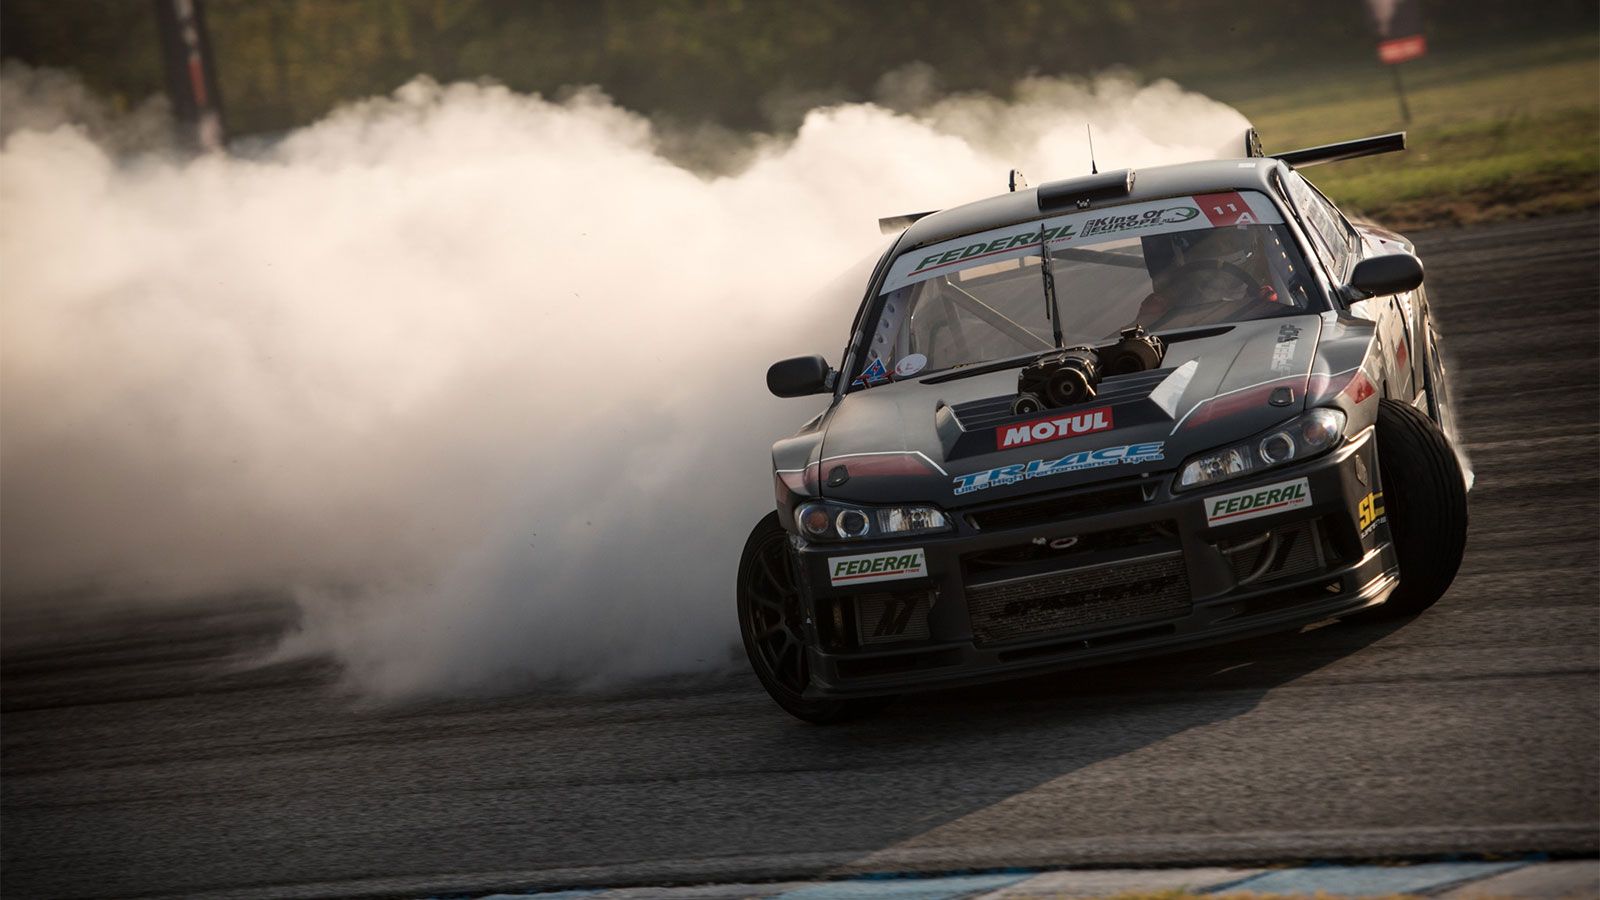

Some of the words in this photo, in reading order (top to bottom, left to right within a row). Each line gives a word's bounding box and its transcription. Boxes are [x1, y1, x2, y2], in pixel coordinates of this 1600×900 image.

[1093, 214, 1138, 227] King
[1143, 209, 1166, 219] Of
[1213, 203, 1237, 215] 11
[1235, 212, 1256, 226] A
[1091, 218, 1160, 232] EUROPE
[914, 224, 1077, 271] FEDERAL
[1003, 412, 1108, 446] MOTUL
[953, 441, 1165, 486] TRI-ACE
[954, 482, 989, 495] Ultra
[991, 474, 1024, 487] High
[1025, 459, 1118, 479] Performance
[1123, 453, 1165, 465] Tyres
[1212, 483, 1305, 516] FEDERAL
[834, 554, 921, 576] FEDERAL
